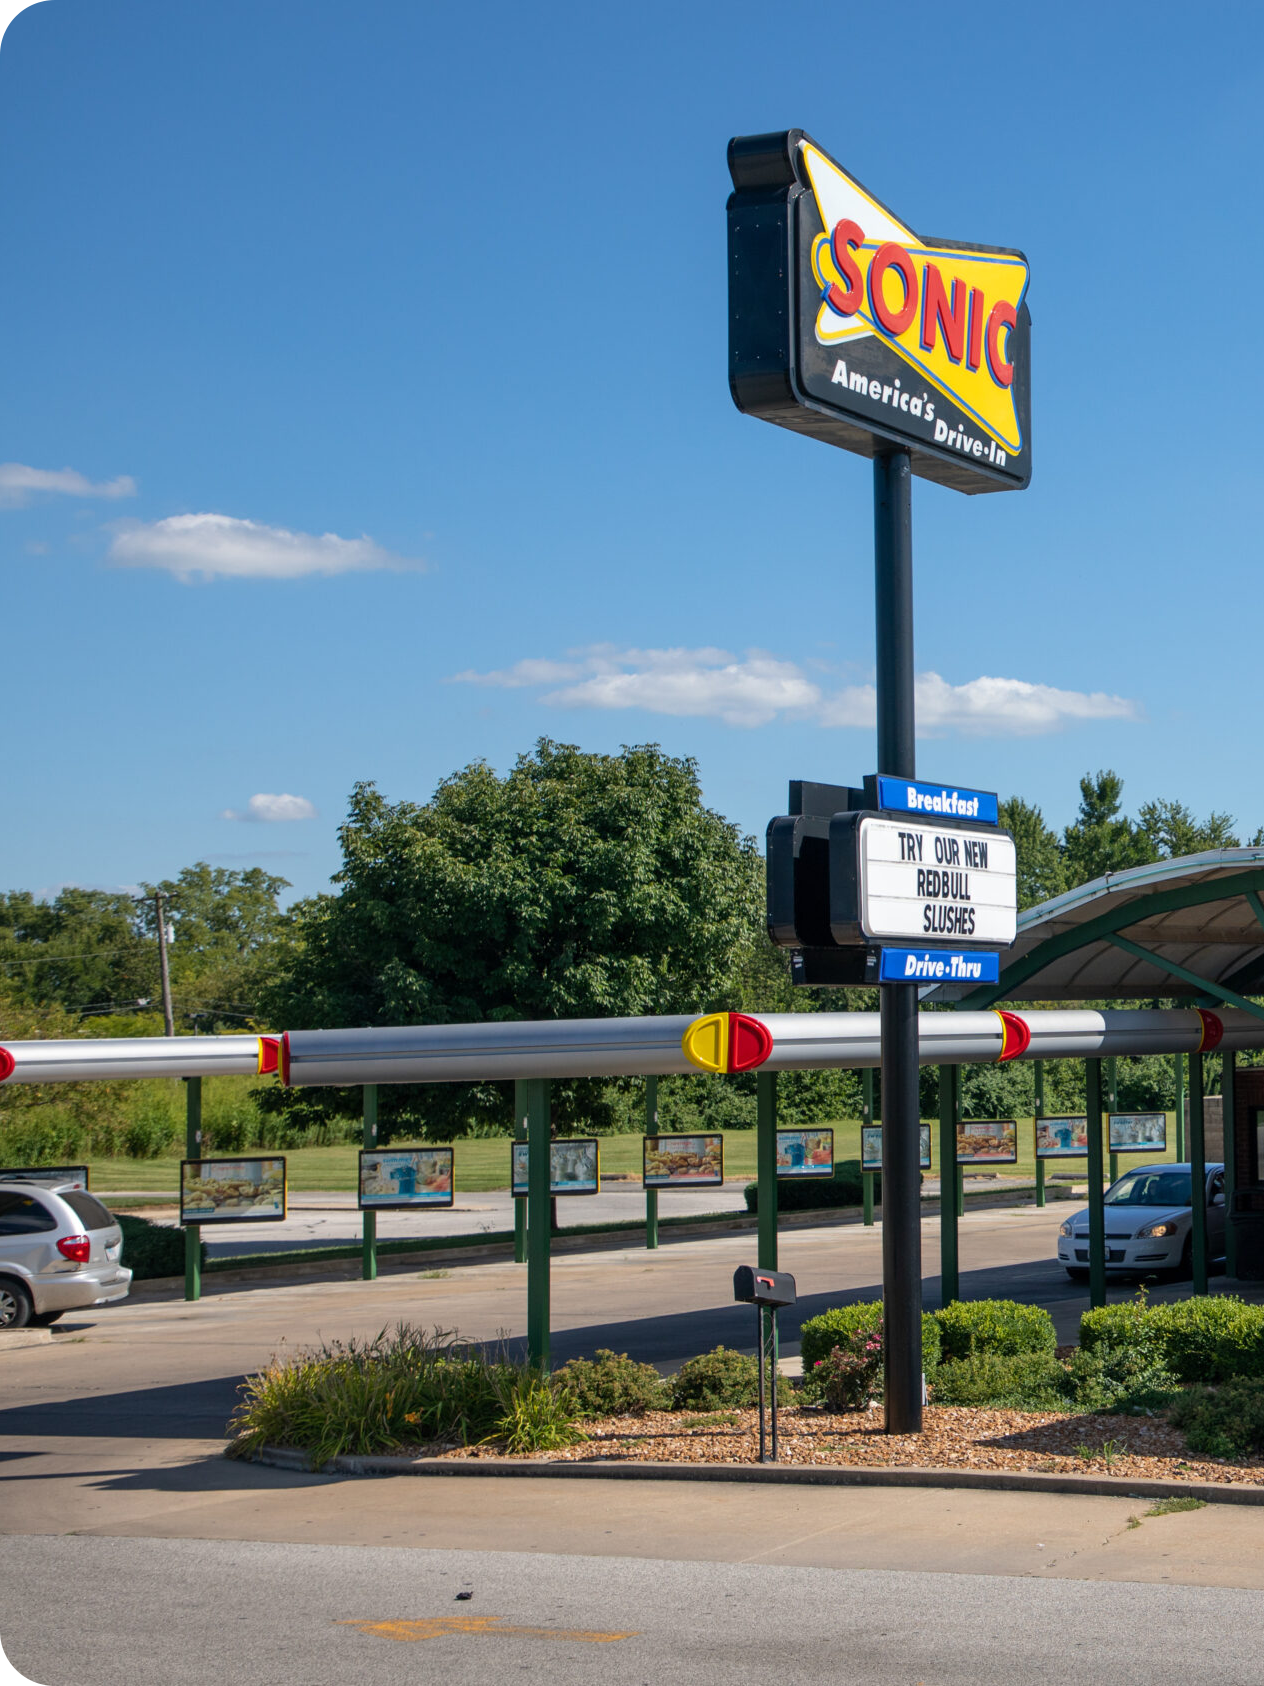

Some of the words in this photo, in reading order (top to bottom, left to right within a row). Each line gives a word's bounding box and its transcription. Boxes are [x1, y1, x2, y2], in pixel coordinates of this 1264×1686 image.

[821, 218, 1017, 389] SONIC
[831, 359, 936, 422] America's
[906, 786, 980, 817] Breakfast
[898, 831, 923, 862] TRY
[934, 836, 960, 866] OUR
[964, 839, 988, 869] NEW
[917, 868, 971, 900] REDBULL
[923, 904, 976, 936] SLUSHES
